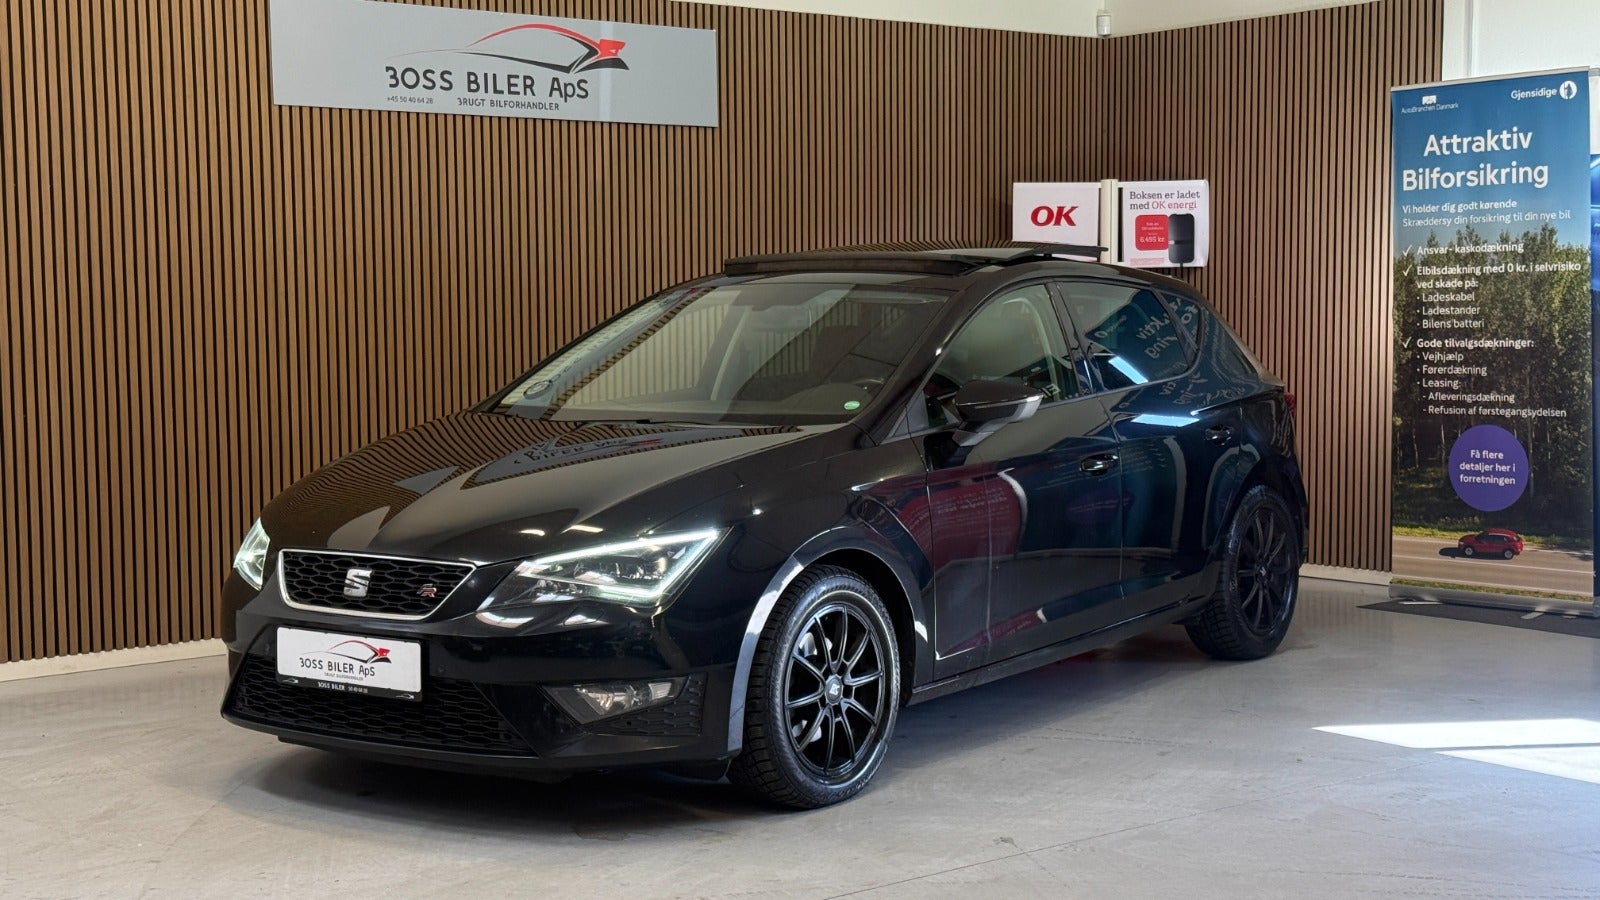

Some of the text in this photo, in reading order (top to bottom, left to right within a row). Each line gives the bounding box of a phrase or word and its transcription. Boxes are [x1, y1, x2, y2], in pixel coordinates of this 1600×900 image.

[466, 71, 536, 97] BILER
[549, 77, 589, 102] ApS
[1510, 88, 1558, 101] Gjensidige
[489, 100, 560, 111] BILFORHANDLER
[1423, 126, 1533, 157] Attraktiv
[1402, 161, 1549, 191] Bilforsikring
[1129, 191, 1163, 200] Boksen
[1176, 190, 1200, 199] ladet
[1129, 200, 1197, 210] med OK energi
[1402, 199, 1518, 214] Vi holder dig godt kørende
[1030, 205, 1079, 227] OK
[1402, 210, 1571, 228] Skræddersy din forsikring til din nye bil
[1454, 242, 1524, 254] kaskodækning
[1416, 262, 1582, 276] Elbilsdækning med 0 kr. i selvrisiko
[1416, 279, 1478, 290] ved skade på:
[1422, 292, 1475, 302] Ladeskabel
[1422, 305, 1480, 316] Ladestander
[1422, 318, 1484, 329] Bilens batteri
[1416, 338, 1535, 350] Gode tilvalgsdækninger:
[1422, 352, 1464, 363] Vejhjælp
[1422, 364, 1488, 376] Førerdækning
[1428, 392, 1516, 404] Afleveringsdækning
[1428, 405, 1567, 418] Refusion af førstegangsydelsen
[1470, 450, 1504, 460] Få flere
[1459, 462, 1516, 473] detaljer her i
[1460, 474, 1516, 486] forretningen
[328, 660, 354, 674] BILER
[358, 665, 376, 678] ApS
